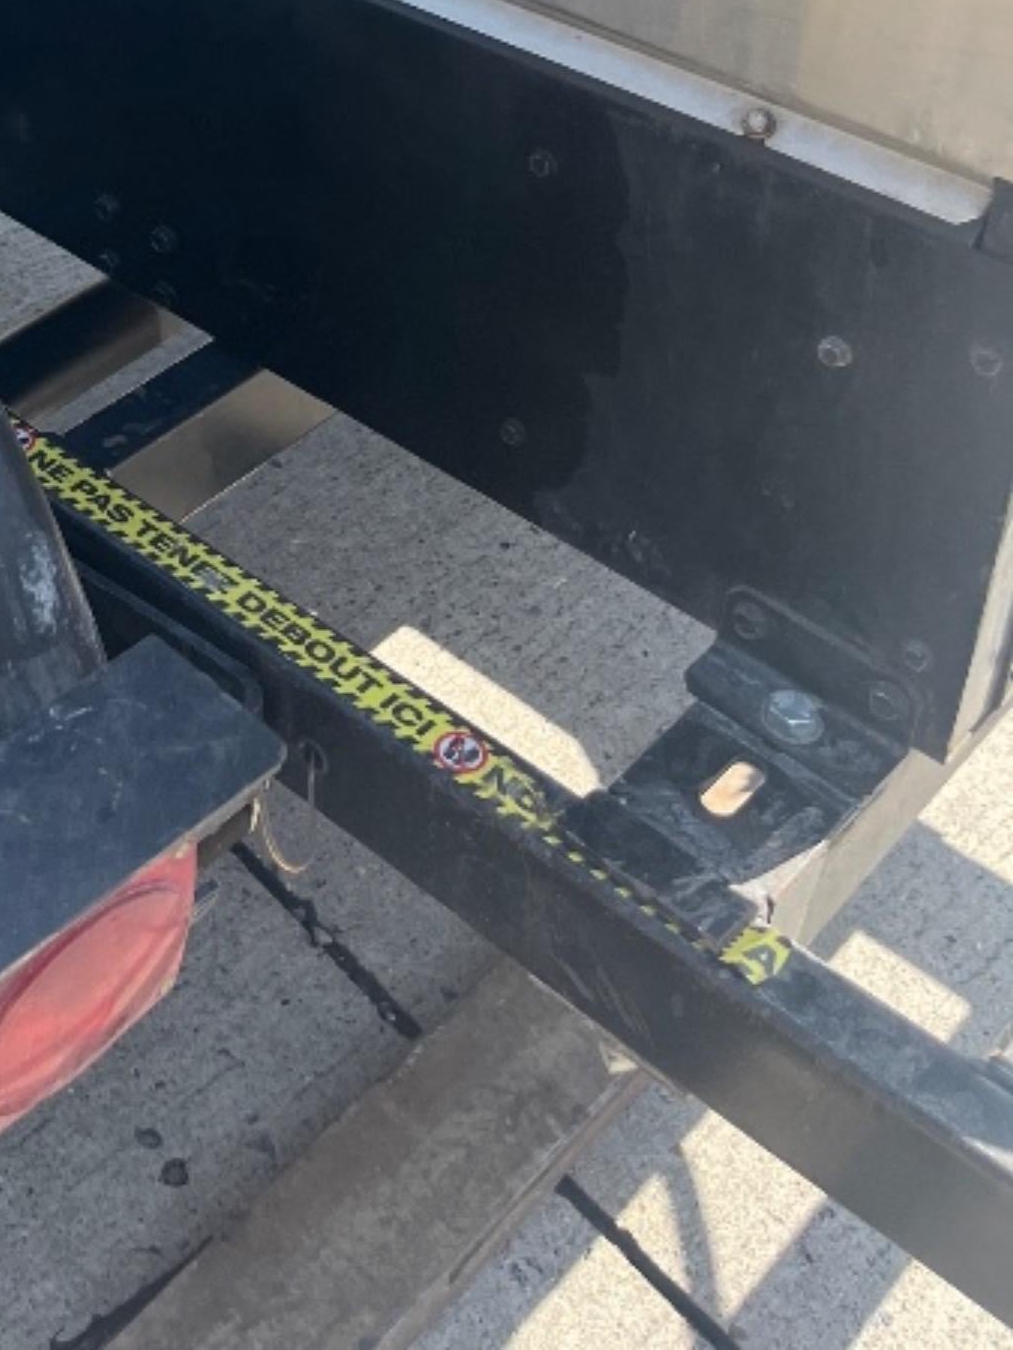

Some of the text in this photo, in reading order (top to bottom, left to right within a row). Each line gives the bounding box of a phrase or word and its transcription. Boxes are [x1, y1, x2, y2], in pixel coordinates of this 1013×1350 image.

[28, 449, 75, 484] NE
[69, 478, 135, 523] PAS
[236, 590, 385, 695] DEBOUT
[379, 692, 437, 737] ICI
